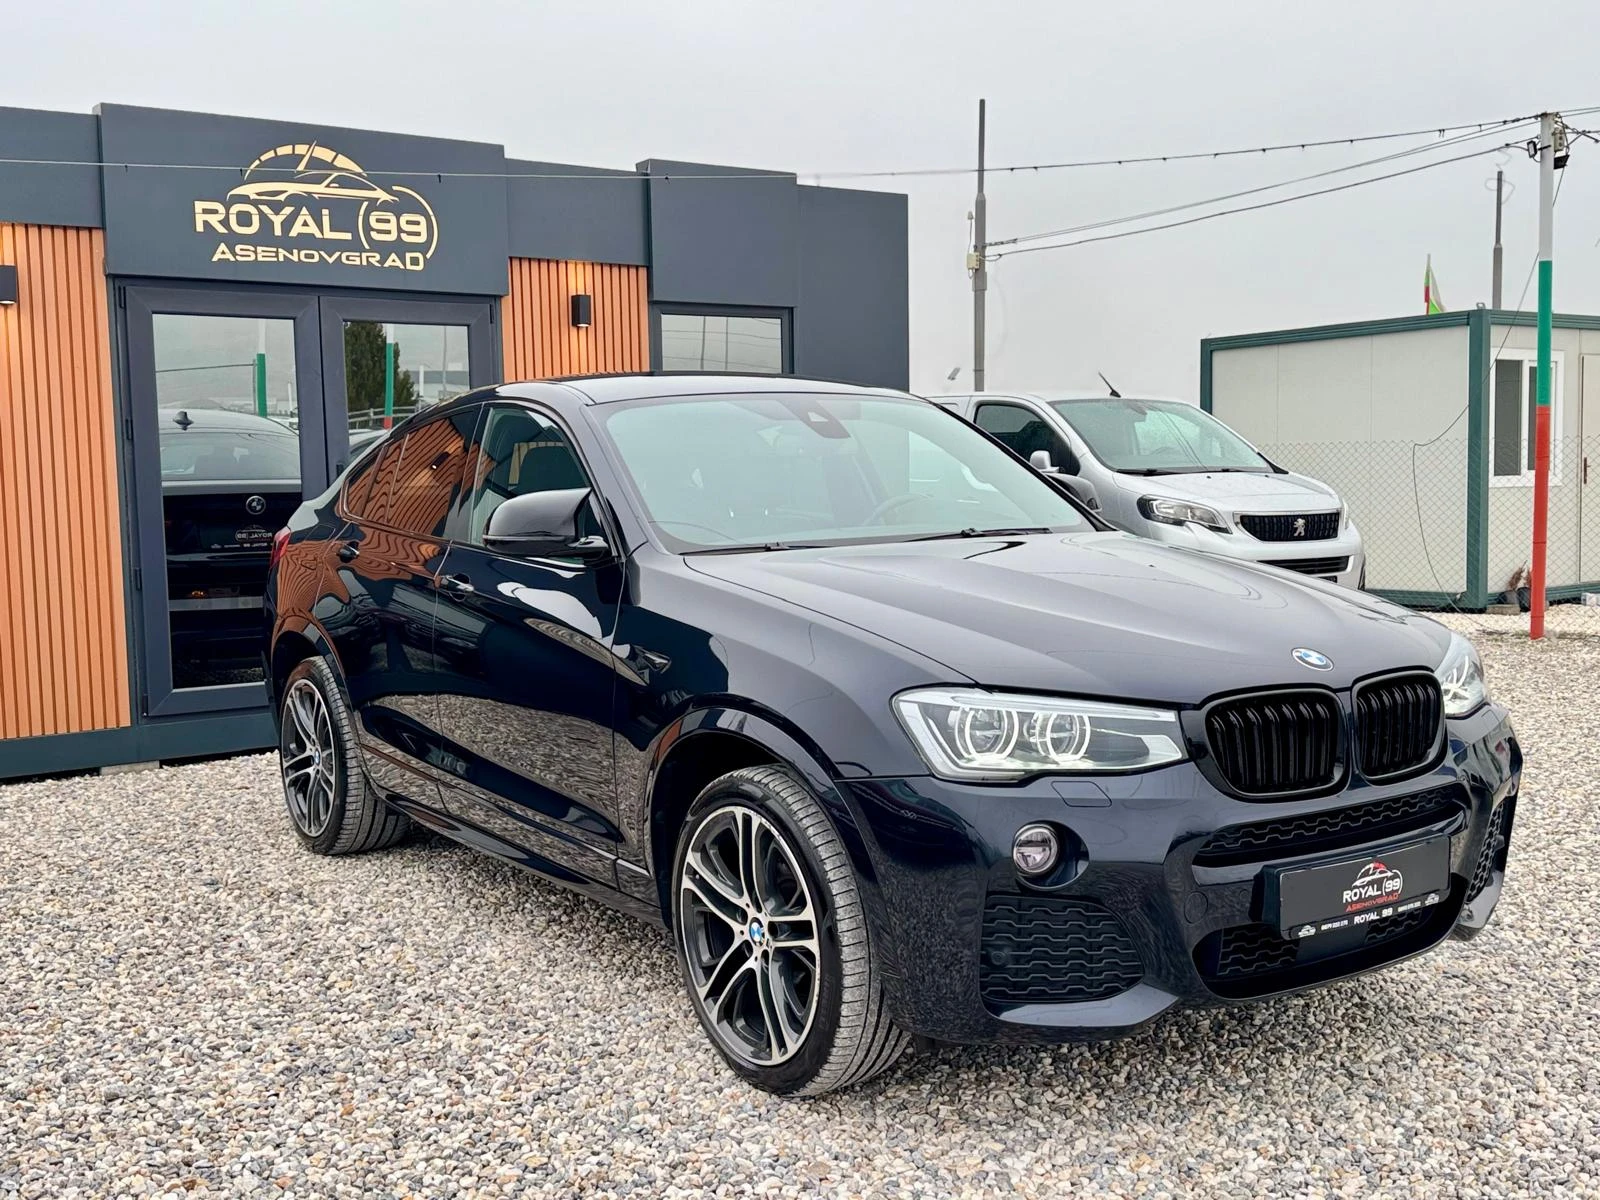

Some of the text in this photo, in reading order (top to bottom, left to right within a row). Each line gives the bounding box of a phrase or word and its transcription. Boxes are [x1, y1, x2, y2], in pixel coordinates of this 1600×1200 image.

[194, 200, 352, 241] ROYAL
[211, 242, 425, 271] ASENOVGRAD
[1343, 884, 1382, 903] ROYAL
[1354, 911, 1380, 925] ROYAL
[1382, 907, 1393, 917] 99
